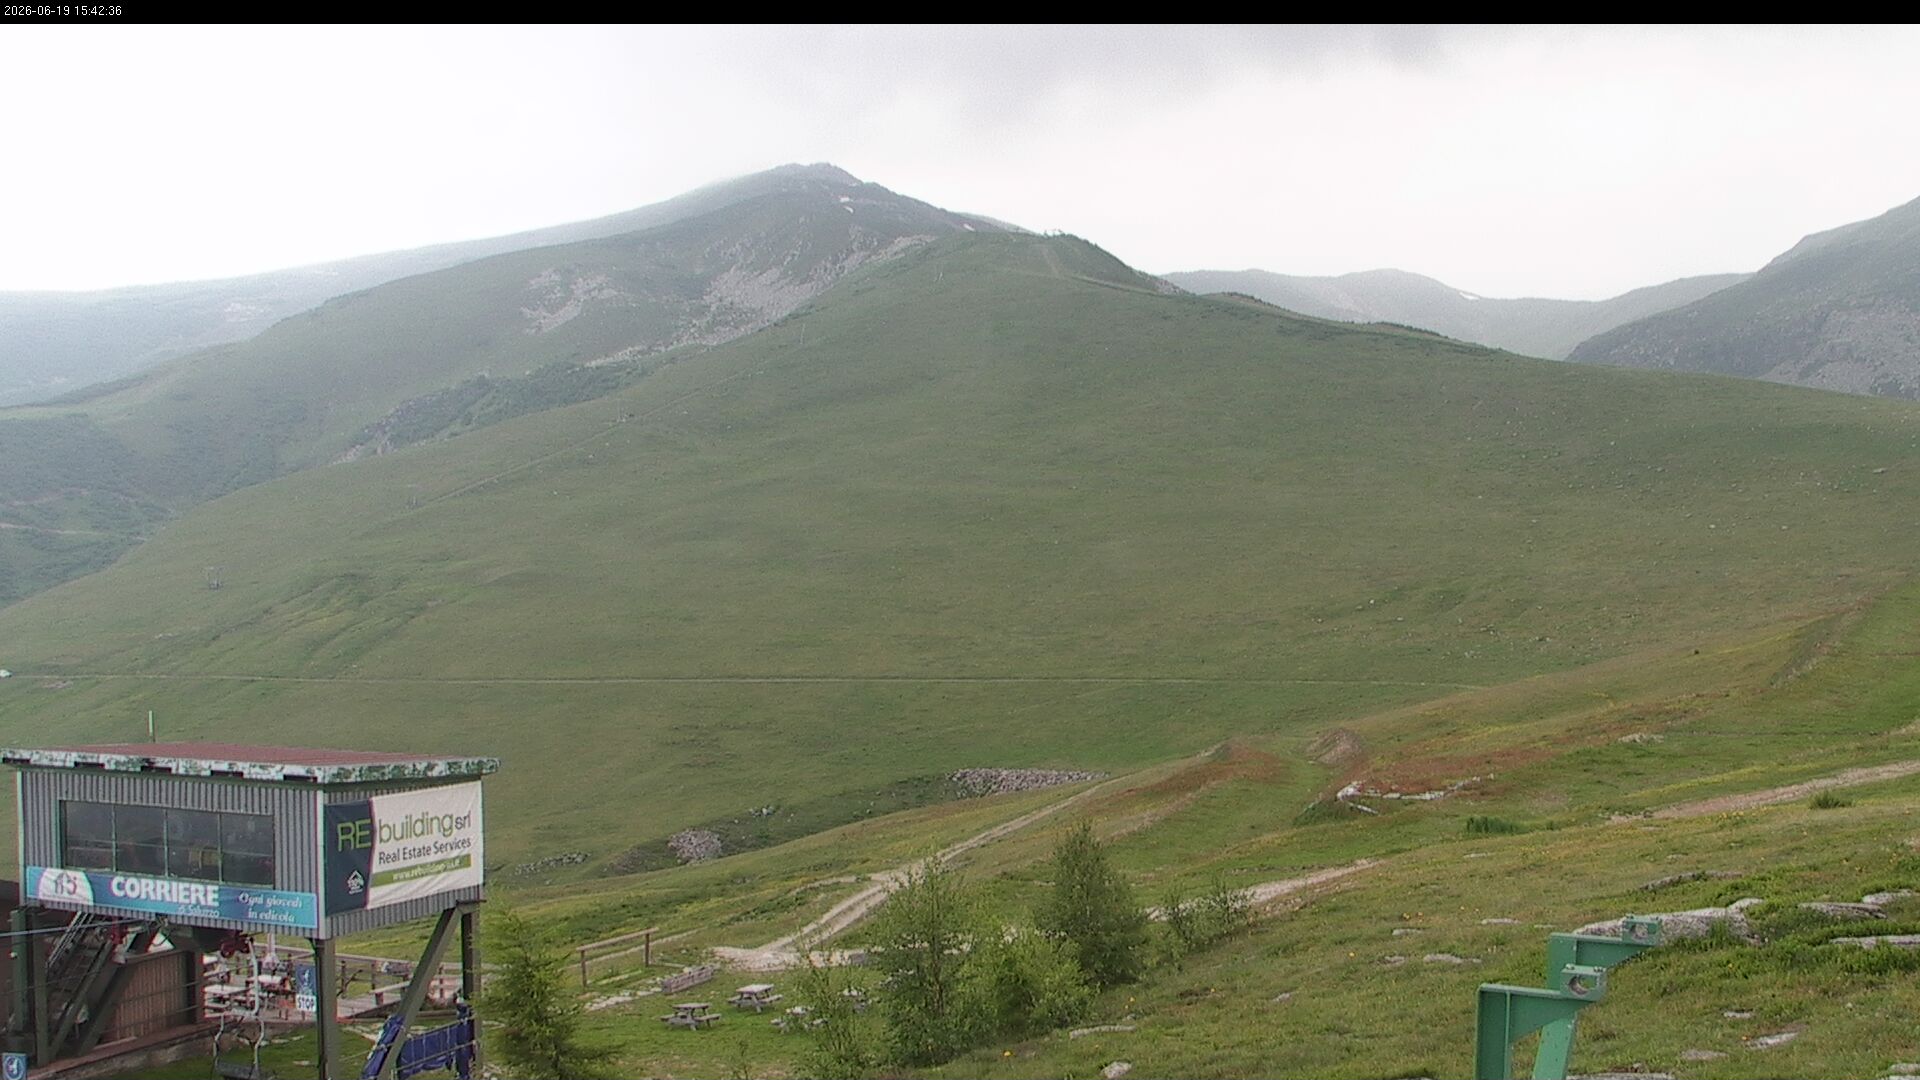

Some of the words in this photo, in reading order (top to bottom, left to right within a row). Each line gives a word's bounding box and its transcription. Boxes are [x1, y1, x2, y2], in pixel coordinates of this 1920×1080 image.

[337, 818, 372, 852] RE
[378, 811, 454, 844] building
[378, 850, 400, 865] Real
[402, 845, 431, 861] Estate
[433, 837, 472, 855] Services
[111, 875, 220, 907] CORRIERE
[239, 892, 264, 906] Ogni
[248, 908, 258, 919] in
[259, 909, 296, 922] edicola
[298, 996, 315, 1010] STOP
